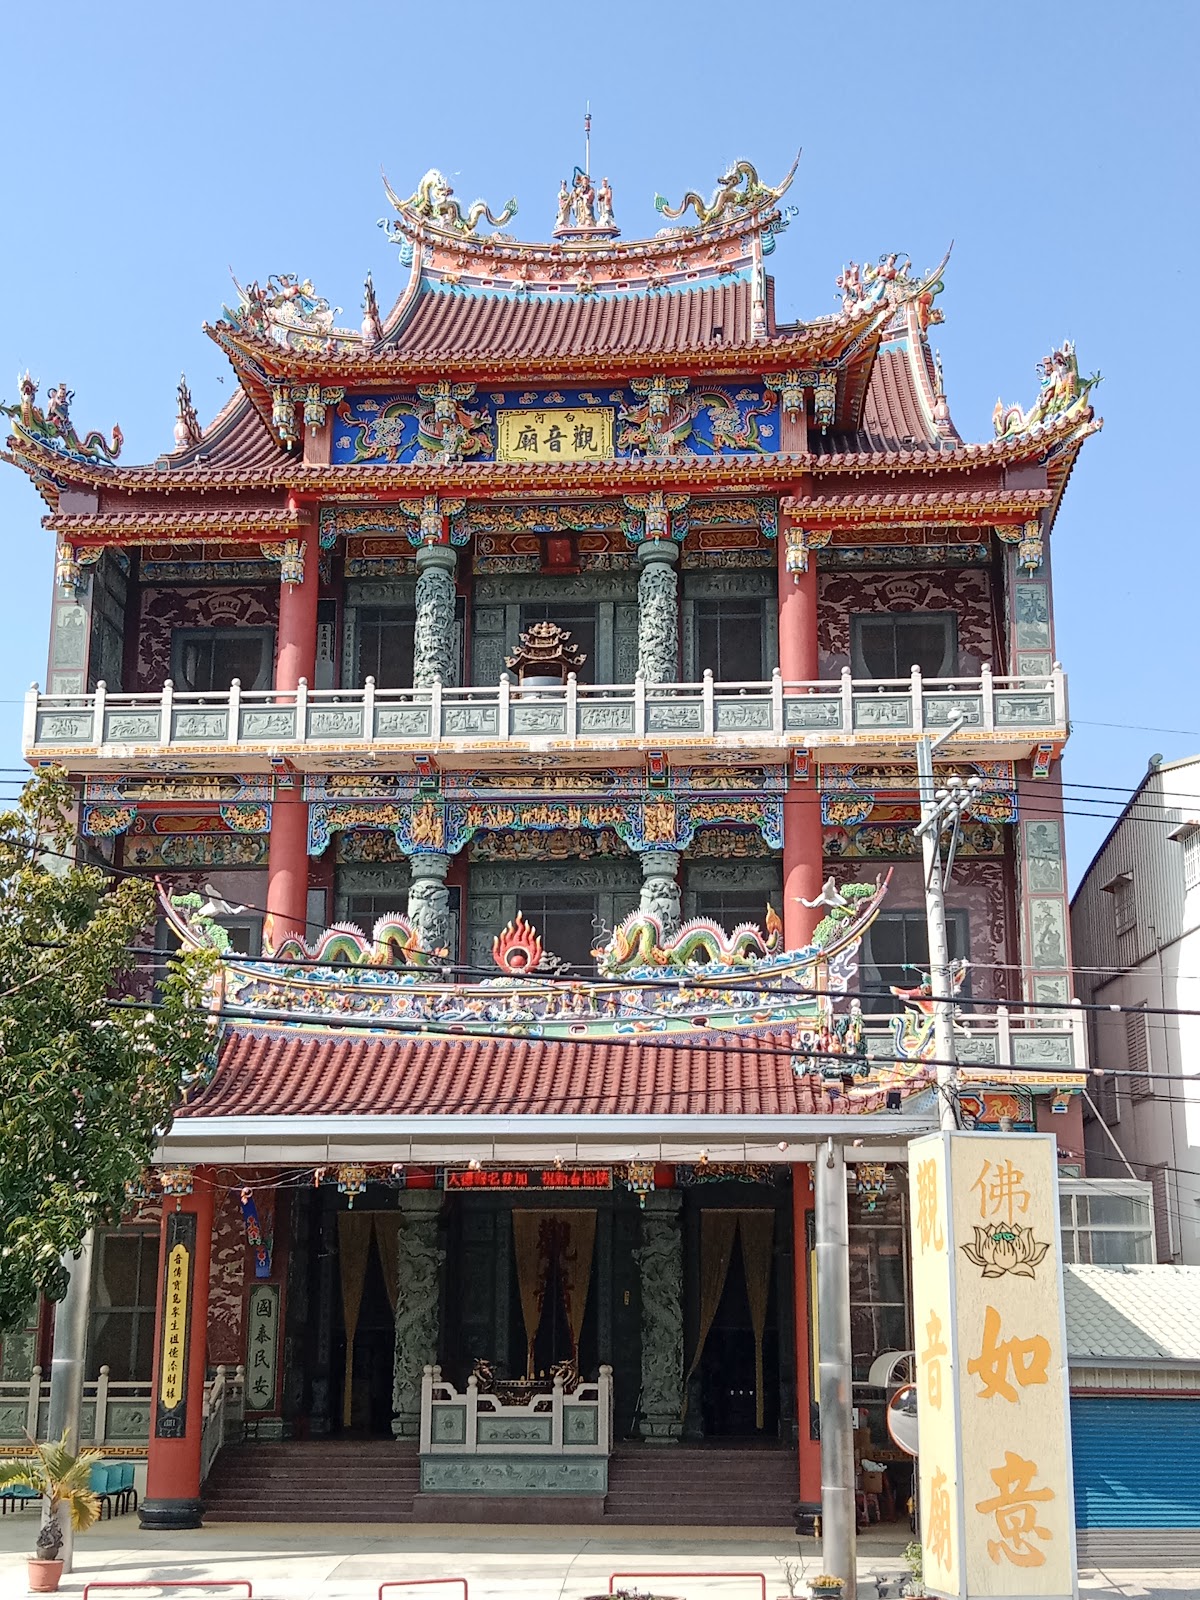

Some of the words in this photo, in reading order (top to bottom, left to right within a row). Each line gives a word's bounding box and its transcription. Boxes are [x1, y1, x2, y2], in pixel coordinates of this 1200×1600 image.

[513, 423, 598, 453] 觀音廟
[534, 412, 576, 424] 白河
[969, 1158, 1031, 1225] 佛
[252, 1298, 272, 1396] 國泰民安
[916, 1159, 953, 1572] 觀音廟
[967, 1305, 1055, 1567] 如意
